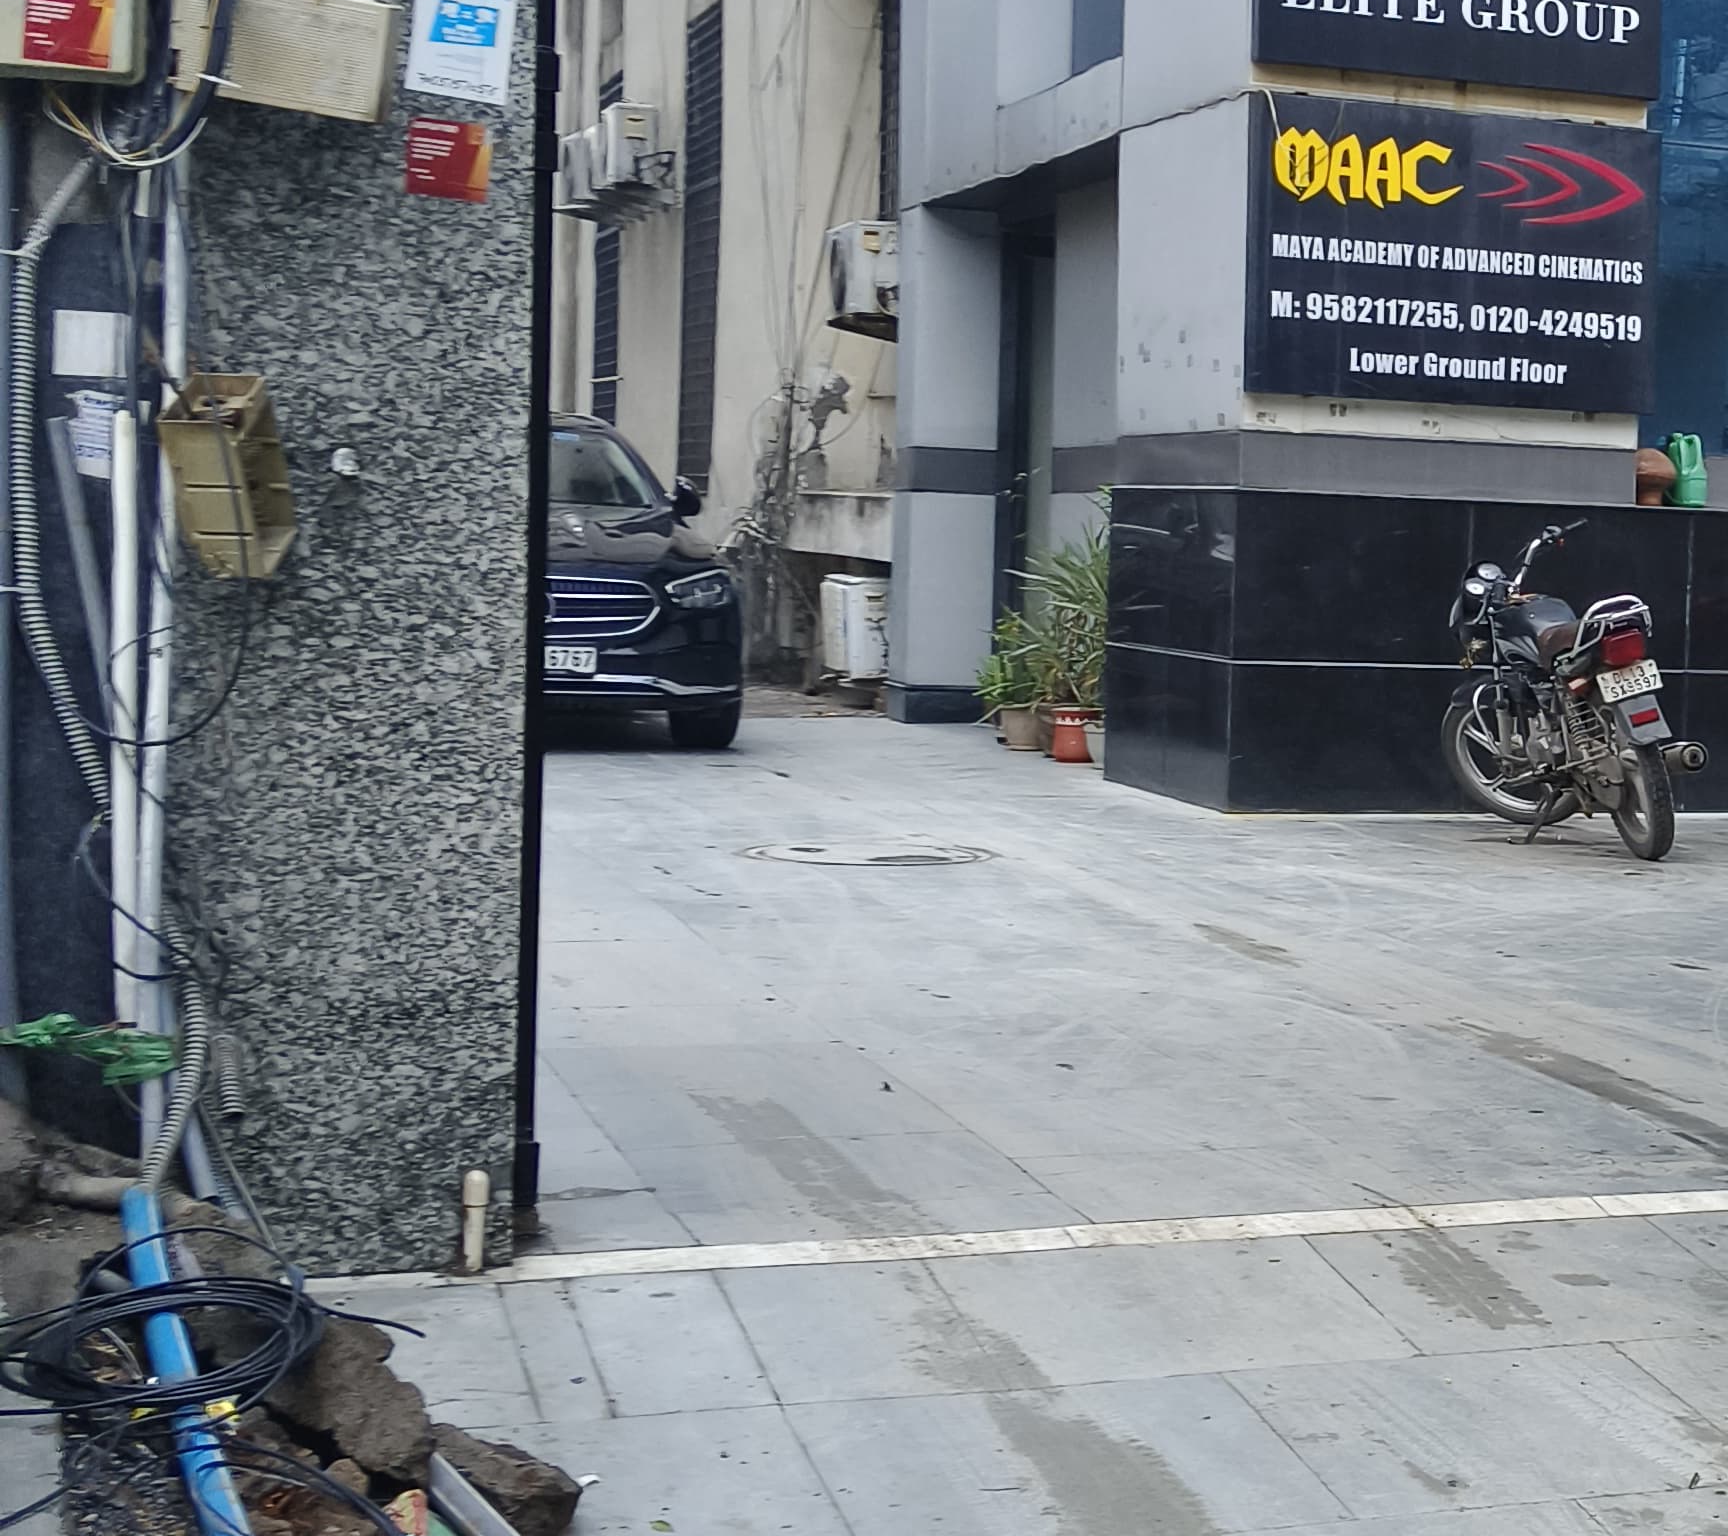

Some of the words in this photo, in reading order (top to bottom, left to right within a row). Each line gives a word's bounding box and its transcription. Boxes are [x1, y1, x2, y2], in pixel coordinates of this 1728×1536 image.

[1274, 126, 1465, 209] MAAC
[1272, 233, 1324, 261] MAYA
[1328, 238, 1414, 269] ACADEMY
[1417, 244, 1440, 270] OF
[1441, 247, 1535, 277] ADVANCED
[1538, 253, 1644, 285] CINEMATICS
[1271, 290, 1301, 320] M:
[1306, 292, 1465, 333] 9582117255,
[1470, 304, 1642, 342] 0120-4249519
[1349, 347, 1419, 376] Lower
[1423, 351, 1506, 383] Ground
[1510, 357, 1568, 386] Floor
